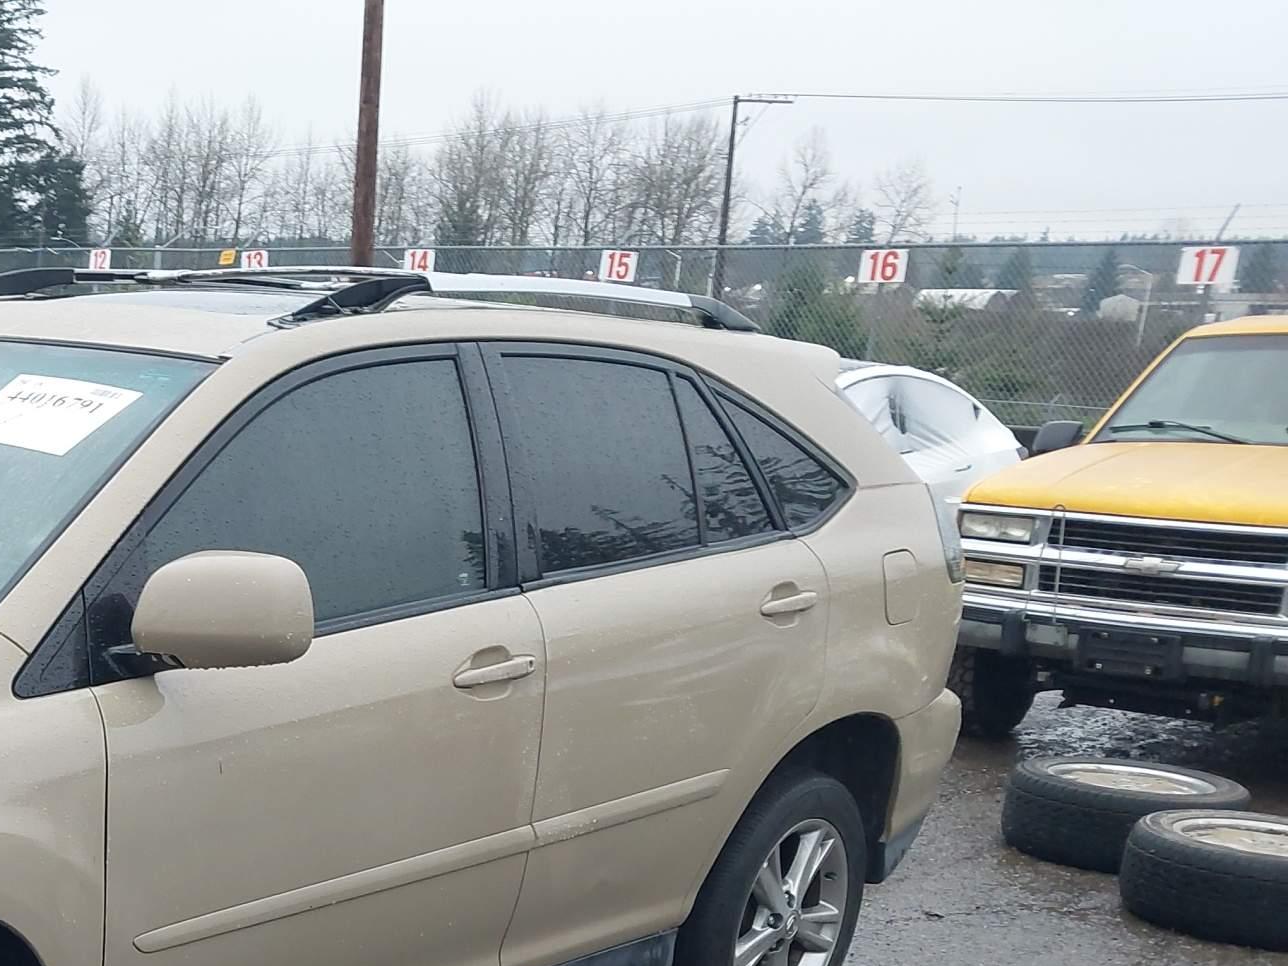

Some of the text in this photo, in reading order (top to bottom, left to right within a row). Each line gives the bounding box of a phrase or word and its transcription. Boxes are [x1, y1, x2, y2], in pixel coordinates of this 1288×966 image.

[94, 250, 106, 270] 12
[246, 251, 264, 268] 13
[410, 251, 429, 271] 14
[608, 252, 631, 280] 15
[870, 251, 899, 281] 16
[1194, 248, 1225, 282] 17
